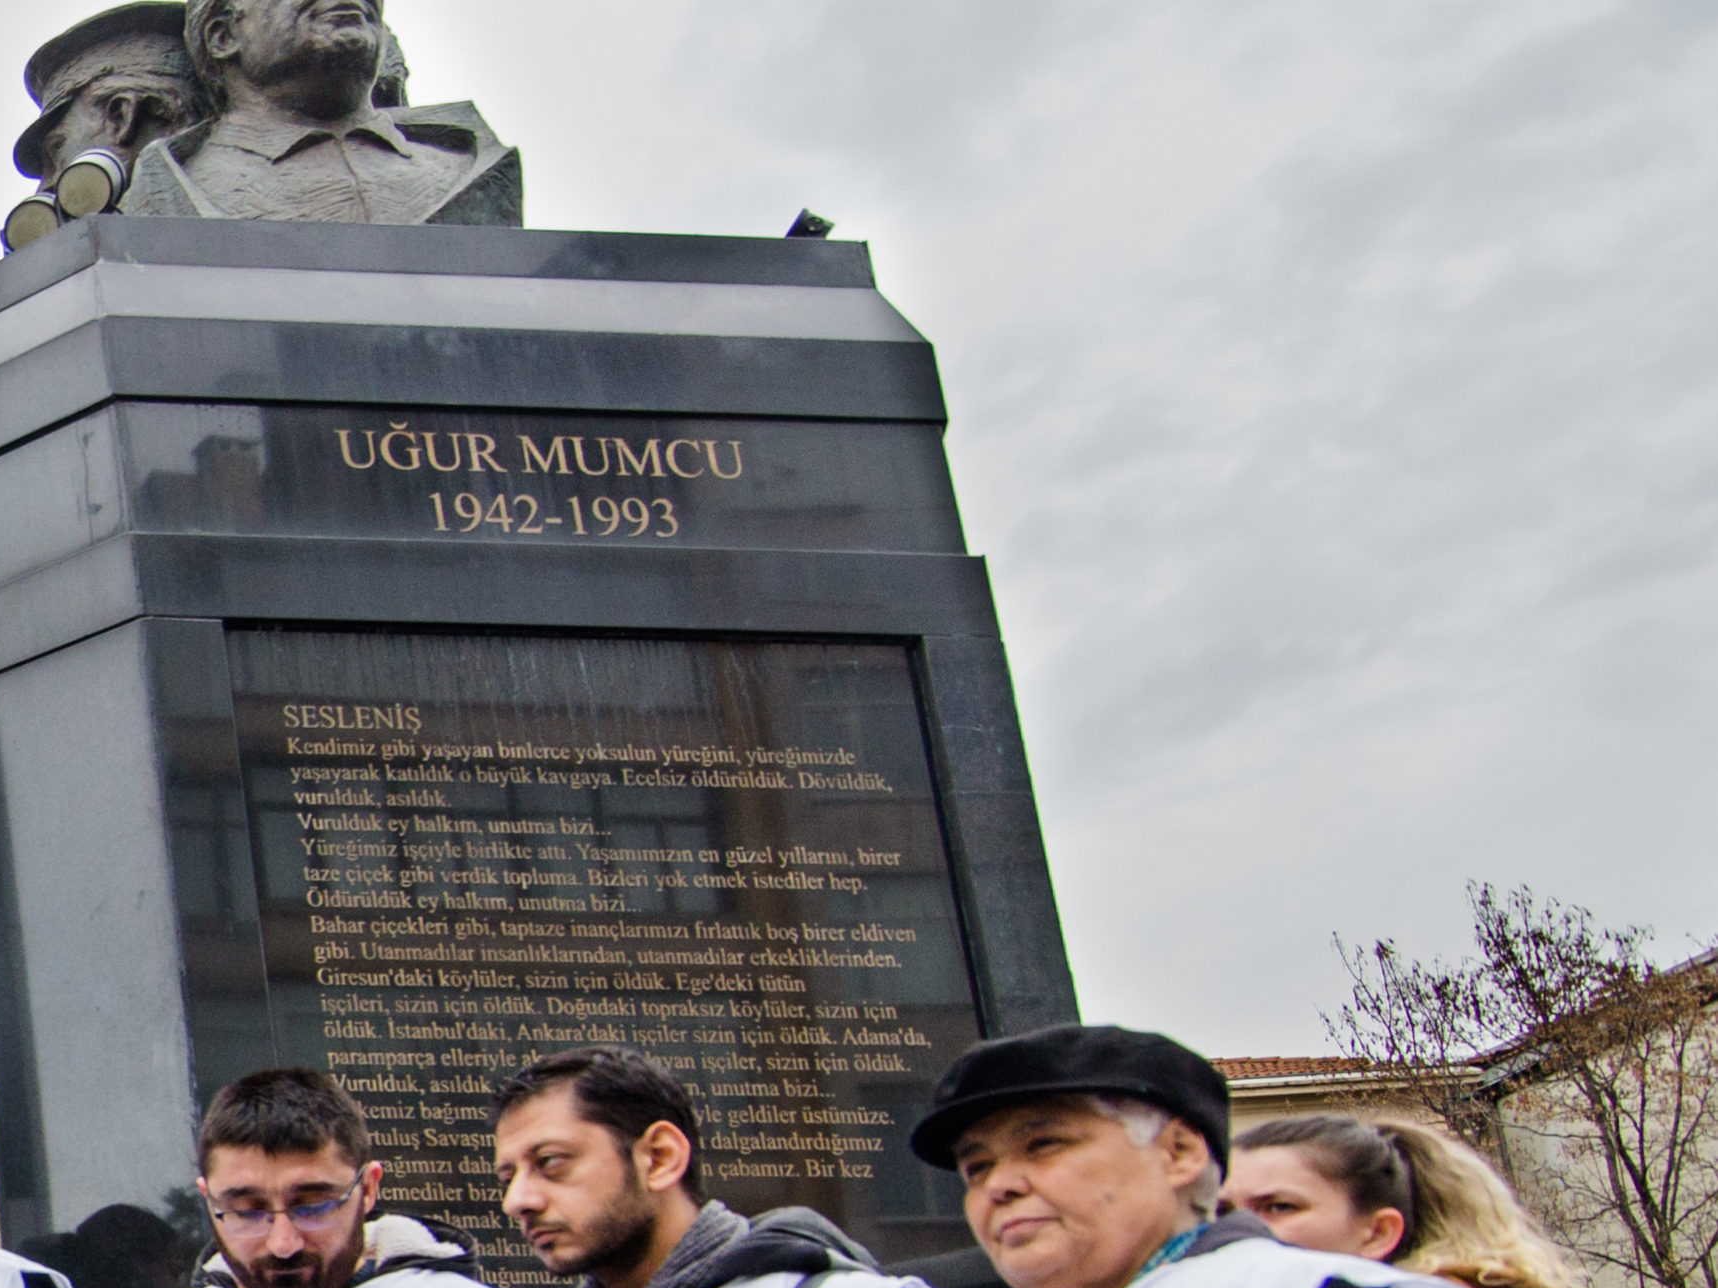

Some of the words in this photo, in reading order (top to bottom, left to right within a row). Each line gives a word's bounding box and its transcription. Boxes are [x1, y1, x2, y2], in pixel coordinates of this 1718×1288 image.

[334, 421, 507, 473] UĞUR
[517, 434, 743, 479] MUMCU
[428, 492, 680, 538] 1942-1993
[283, 703, 422, 735] SESLENİŞ
[287, 738, 376, 756] Kendimiz
[382, 739, 416, 762] gibi
[421, 745, 494, 764] yaşayan
[498, 741, 570, 760] binlerce
[576, 743, 656, 766] yoksulun
[746, 746, 855, 770] yüreğimizde
[291, 763, 380, 787] yaşayarak
[386, 764, 455, 783] katıldık
[459, 770, 471, 784] o
[476, 766, 532, 789] büyük
[538, 767, 617, 791] kavgaya.
[623, 768, 686, 787] Ecelsiz
[692, 770, 793, 788] öldürüldük.
[799, 772, 892, 794] Dövüldük,
[294, 788, 382, 810] vurulduk,
[386, 789, 451, 807] asıldık.
[297, 813, 382, 831] Vurulduk
[388, 819, 409, 837] ey
[416, 815, 483, 837] halkım,
[489, 818, 555, 834] unutma
[560, 817, 612, 836] bizi...
[404, 839, 462, 863] işçiyle
[466, 840, 532, 859] birlikte
[698, 849, 720, 862] en
[725, 845, 773, 868] güzel
[858, 847, 901, 865] birer
[304, 865, 340, 881] taze
[346, 864, 395, 887] çiçek
[400, 864, 434, 888] gibi
[440, 865, 498, 884] verdik
[503, 866, 582, 890] topluma.
[588, 868, 648, 886] Bizleri
[656, 869, 687, 892] yok
[694, 869, 746, 888] etmek
[754, 871, 824, 889] istediler
[829, 872, 868, 895] hep.
[306, 887, 412, 909] Öldürüldük
[418, 896, 438, 915] ey
[444, 892, 513, 914] halkım,
[518, 896, 586, 912] unutma
[591, 894, 642, 913] bizi...
[310, 916, 365, 934] Bahar
[370, 917, 448, 940] çiçekleri
[455, 918, 496, 941] gibi,
[500, 921, 565, 942] taptaze
[570, 920, 689, 943] inançlarımızı
[766, 922, 798, 945] boş
[803, 922, 846, 941] birer
[850, 923, 916, 942] eldiven
[314, 941, 354, 965] gibi.
[361, 942, 475, 961] Utanmadılar
[638, 946, 744, 965] utanmadılar
[750, 948, 901, 967] erkekliklerinden.
[317, 968, 432, 986] Giresun'daki
[440, 969, 520, 993] köylüler,
[525, 971, 568, 989] sizin
[574, 971, 608, 994] için
[614, 971, 670, 990] öldük.
[677, 972, 753, 996] Ege'deki
[759, 974, 806, 992] tütün
[321, 994, 390, 1017] işçileri,
[395, 995, 438, 1013] sizin
[444, 996, 478, 1019] için
[483, 996, 540, 1014] öldük.
[547, 997, 636, 1020] Doğudaki
[641, 998, 725, 1021] topraksız
[731, 999, 810, 1023] köylüler,
[815, 1000, 858, 1018] sizin
[863, 1001, 897, 1024] için
[324, 1020, 381, 1038] öldük.
[388, 1018, 511, 1043] İstanbul'daki,
[517, 1023, 626, 1041] Ankara'daki
[632, 1024, 686, 1048] işçiler
[693, 1025, 736, 1043] sizin
[741, 1026, 775, 1049] için
[780, 1026, 836, 1045] öldük.
[843, 1027, 931, 1049] Adana'da,
[328, 1053, 435, 1072] paramparça
[441, 1049, 517, 1073] elleriyle
[702, 1052, 762, 1075] işçiler,
[766, 1053, 809, 1071] sizin
[814, 1053, 849, 1076] için
[854, 1053, 910, 1072] öldük.
[430, 1075, 496, 1093] asıldık.
[712, 1081, 780, 1097] unutma
[783, 1080, 836, 1098] bizi...
[363, 1101, 414, 1119] kemiz
[420, 1102, 488, 1125] bağıms
[728, 1105, 796, 1129] geldiler
[802, 1107, 895, 1125] üstümüze.
[368, 1127, 420, 1150] rtuluş
[711, 1132, 883, 1155] dalgalandırdığımız
[718, 1158, 800, 1182] çabamız.
[805, 1159, 834, 1178] Bir
[841, 1159, 873, 1178] kez
